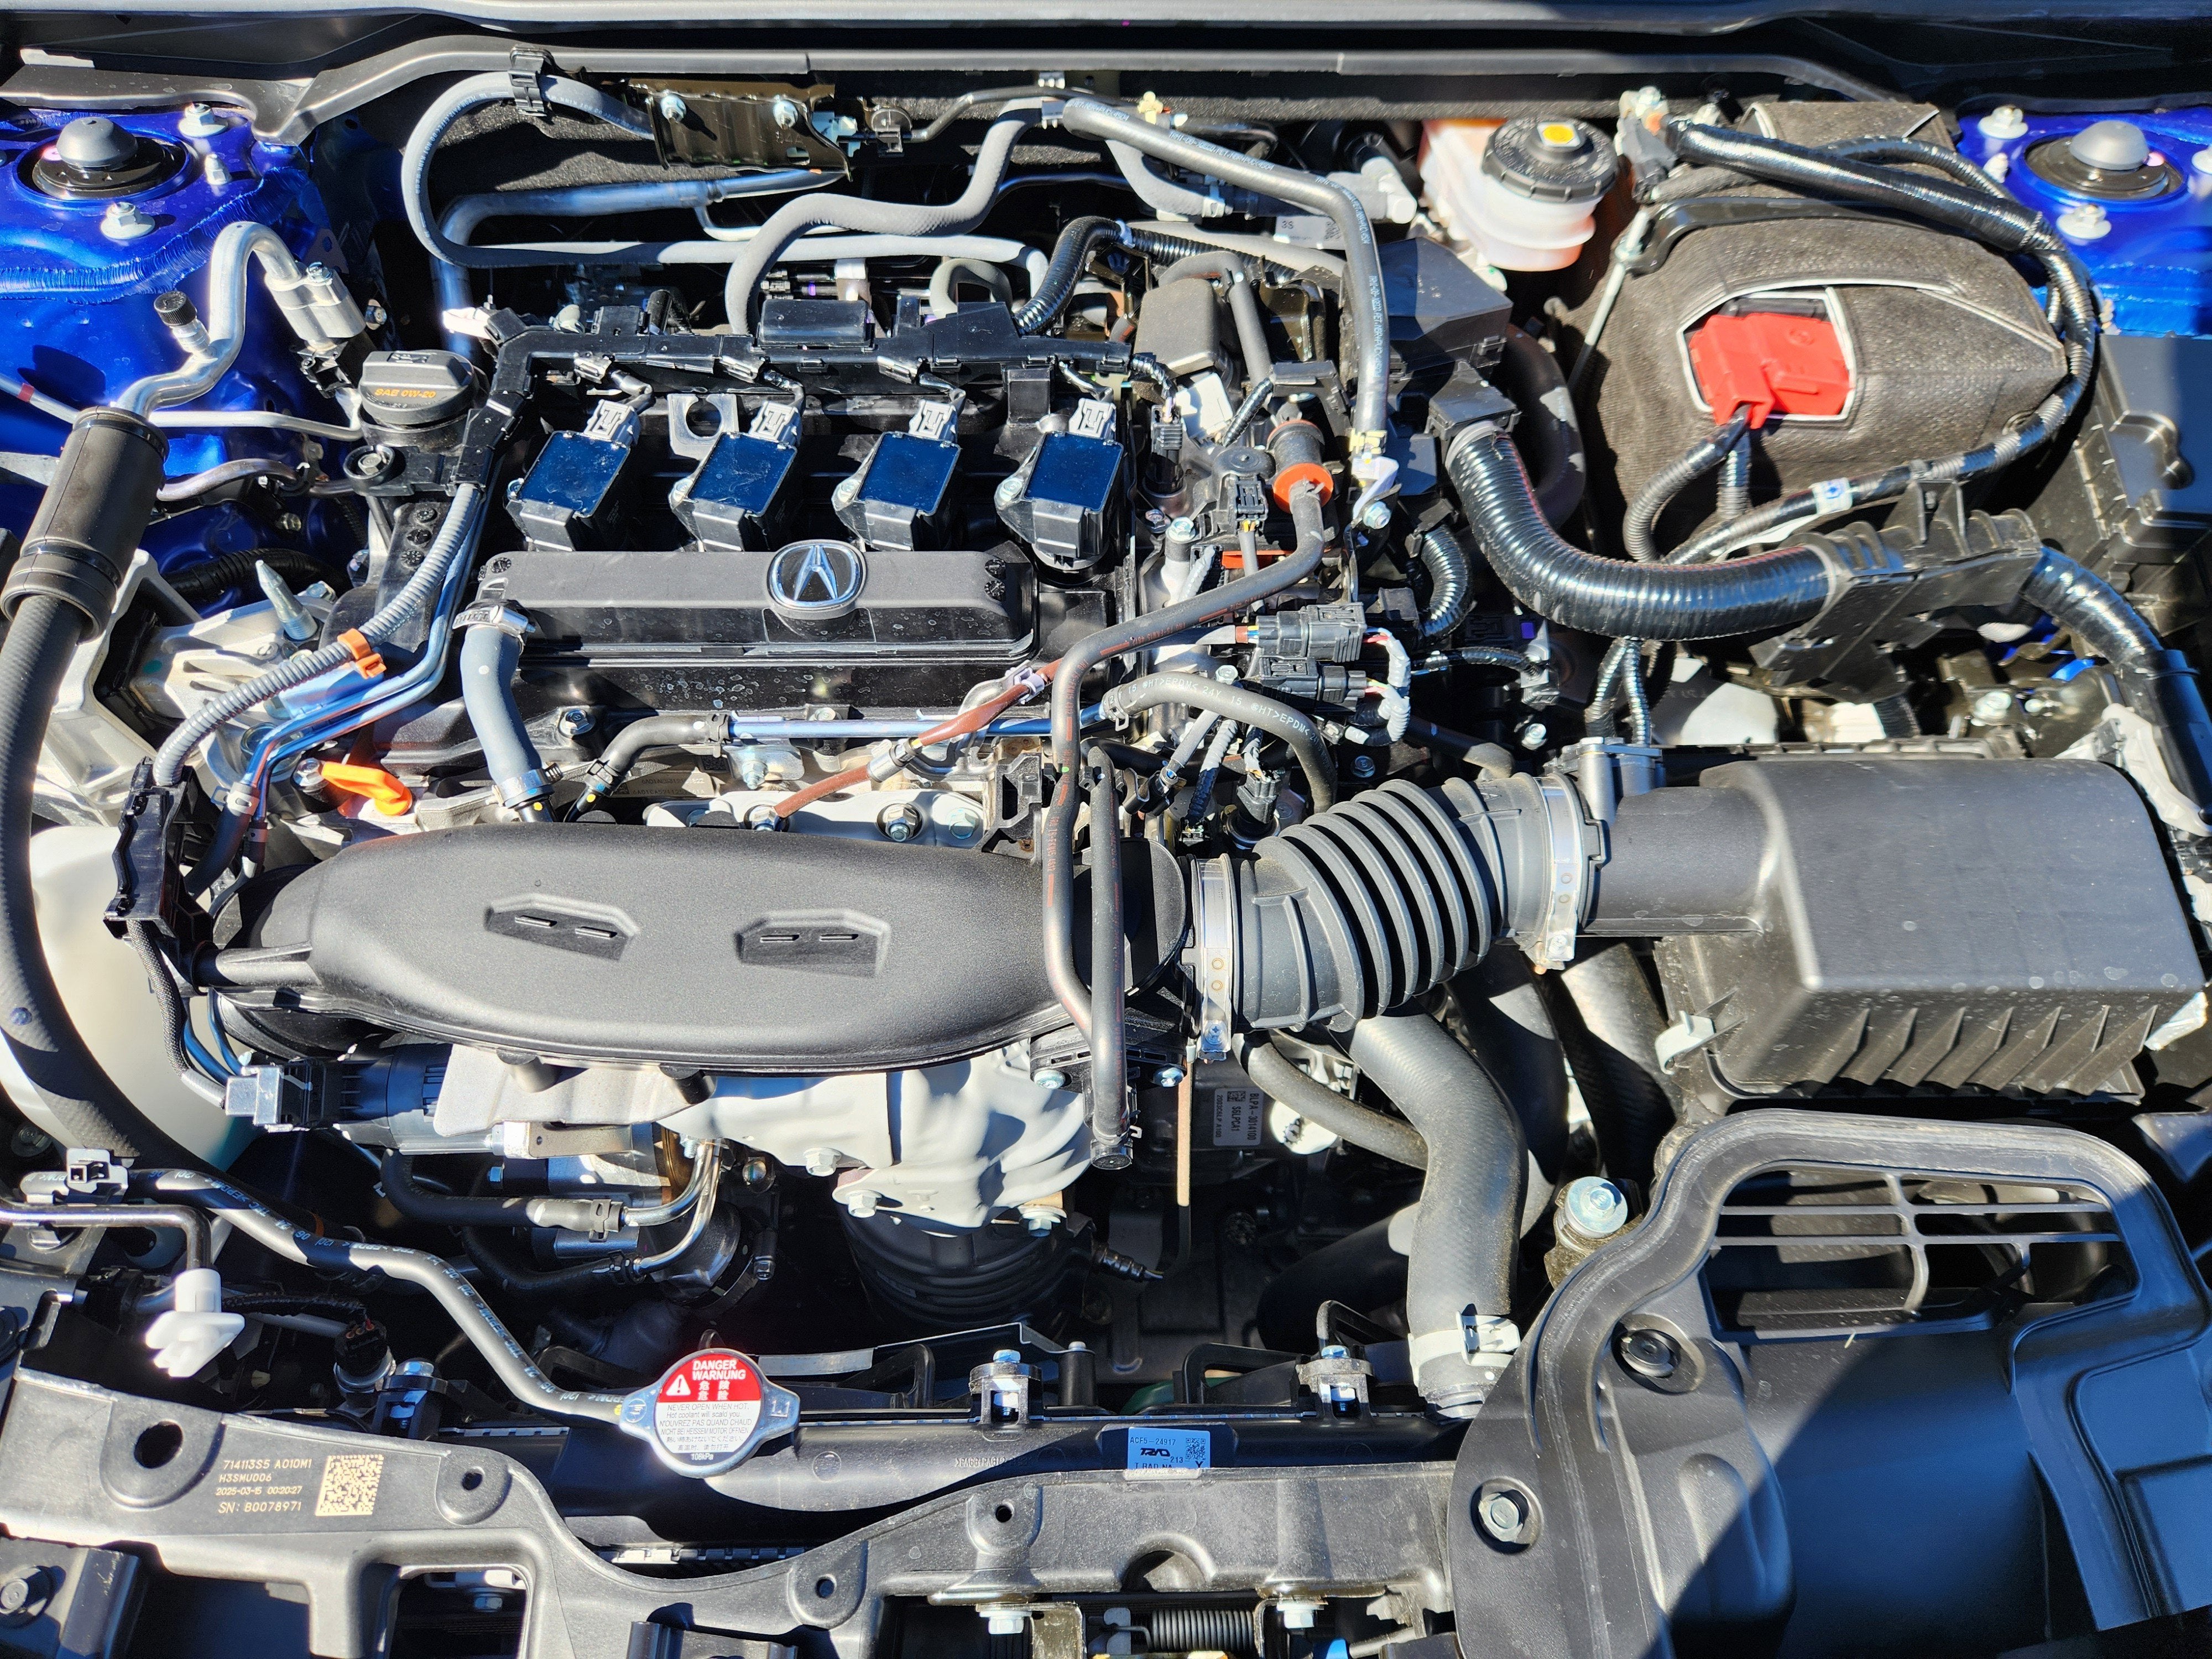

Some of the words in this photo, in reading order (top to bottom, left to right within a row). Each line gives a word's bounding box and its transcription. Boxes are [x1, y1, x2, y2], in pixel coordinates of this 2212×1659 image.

[374, 388, 400, 397] SAE
[400, 389, 436, 399] 0W-20
[692, 1359, 738, 1371] DANGER
[692, 1369, 747, 1381] WARNUNG
[691, 1452, 714, 1460] 108kPa
[223, 1459, 270, 1470] 714113S5
[274, 1458, 312, 1469] A010M1
[218, 1473, 272, 1483] H3SMU006
[215, 1486, 262, 1496] 2025-03-15
[267, 1485, 303, 1495] 00:20:27
[217, 1501, 240, 1514] SN:
[244, 1501, 302, 1512] B0078971
